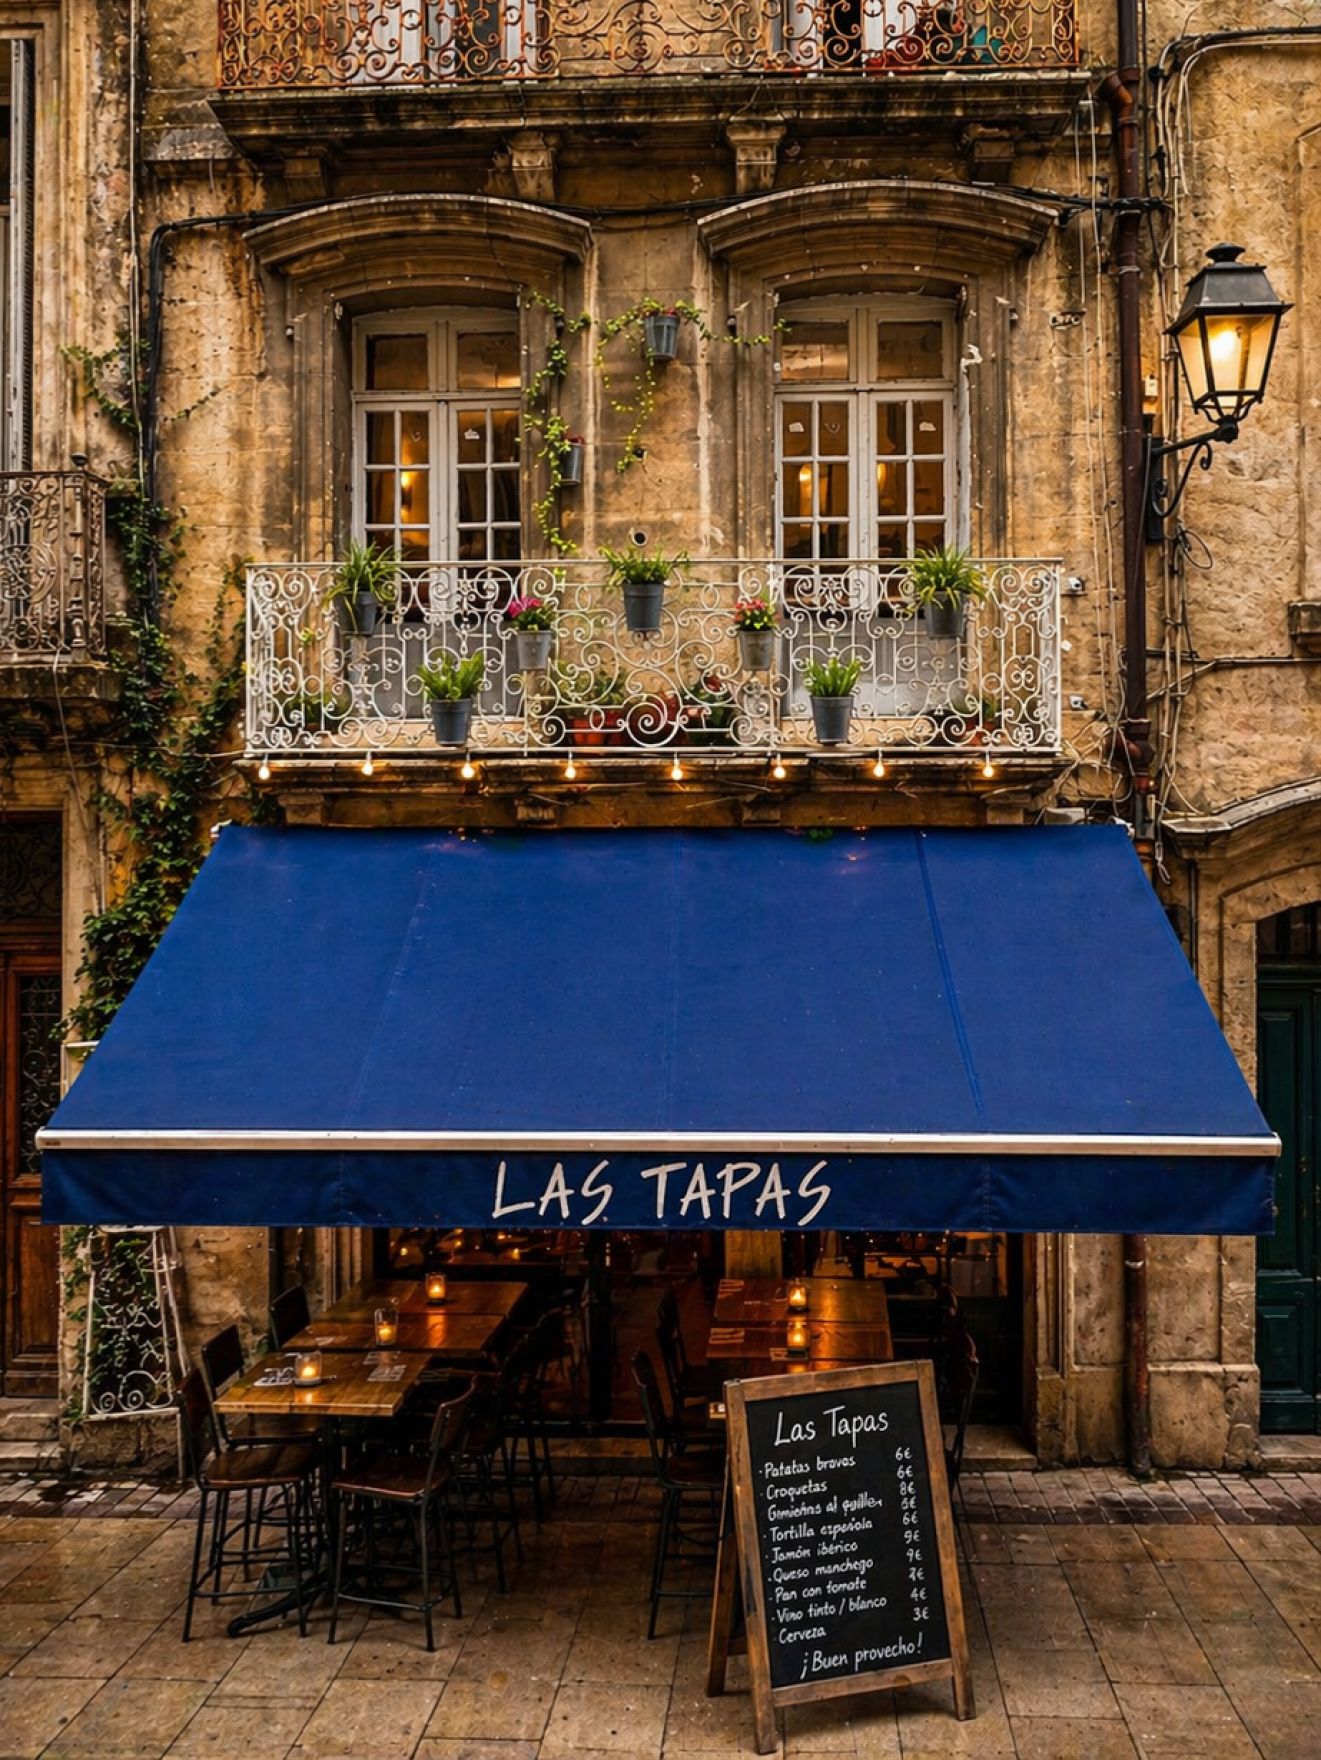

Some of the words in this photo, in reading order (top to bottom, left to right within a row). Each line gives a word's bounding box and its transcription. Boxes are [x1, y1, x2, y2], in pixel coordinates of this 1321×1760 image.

[492, 1159, 614, 1226] LAS
[640, 1159, 832, 1227] TAPAS
[774, 1411, 817, 1446] Las
[822, 1405, 889, 1448] Tapas
[764, 1460, 810, 1479] Patatas
[816, 1455, 857, 1472] bravas
[895, 1447, 913, 1461] 6€
[766, 1479, 828, 1502] Croquetas
[769, 1522, 815, 1542] Tortilla
[771, 1545, 811, 1564] Jamón
[775, 1586, 798, 1604] Pan
[802, 1587, 823, 1598] con
[849, 1595, 888, 1613] blanco
[854, 1632, 923, 1672] provecho!
